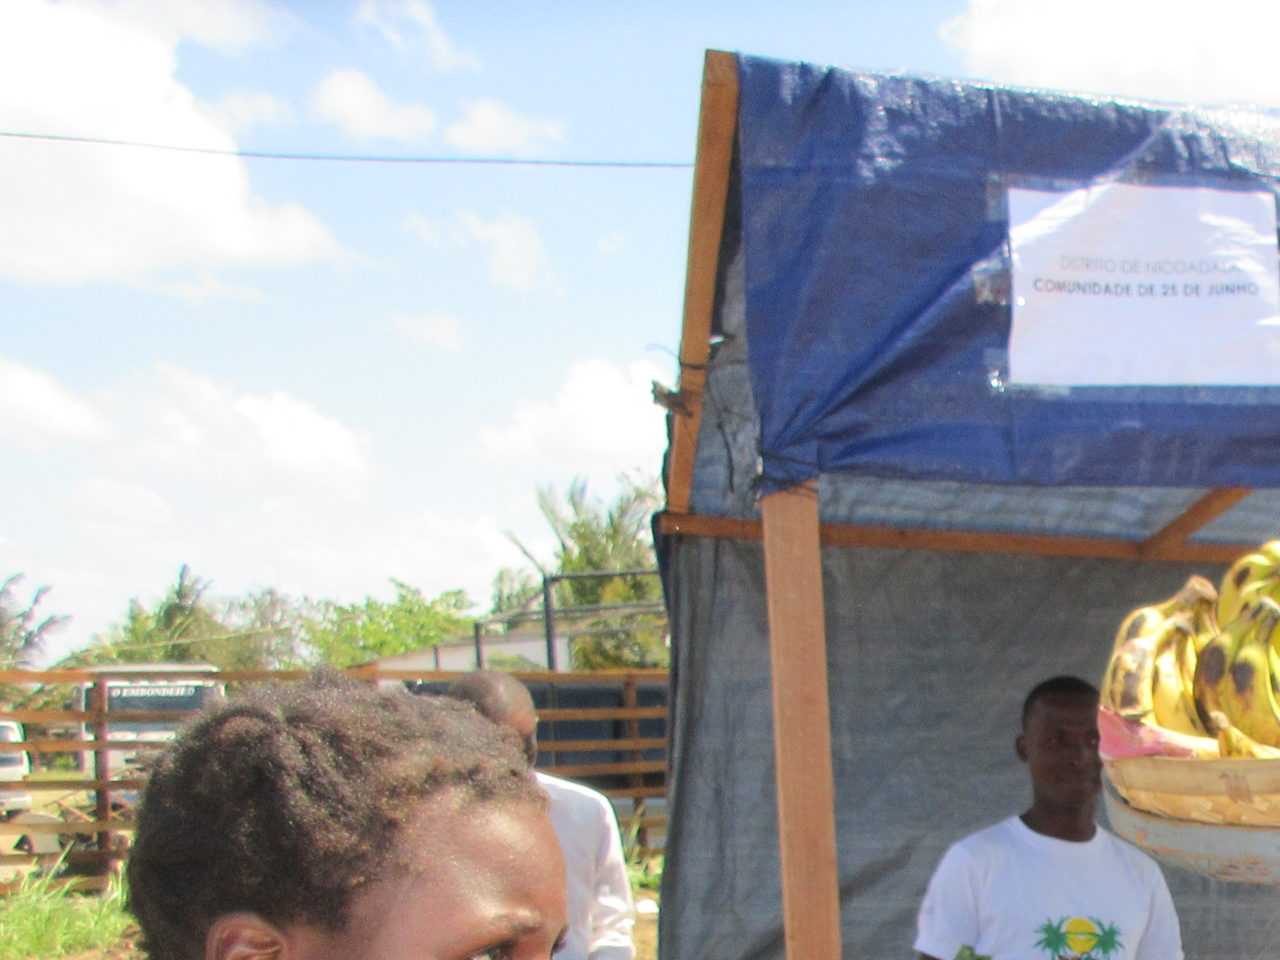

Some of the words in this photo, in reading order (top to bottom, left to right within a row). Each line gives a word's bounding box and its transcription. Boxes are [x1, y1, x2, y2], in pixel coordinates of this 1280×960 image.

[1120, 258, 1140, 273] DE
[1033, 277, 1132, 295] COMUNIDADE
[1137, 282, 1156, 297] DE
[1161, 282, 1179, 297] 25
[1183, 282, 1201, 297] DE
[1206, 280, 1260, 297] JUNHO
